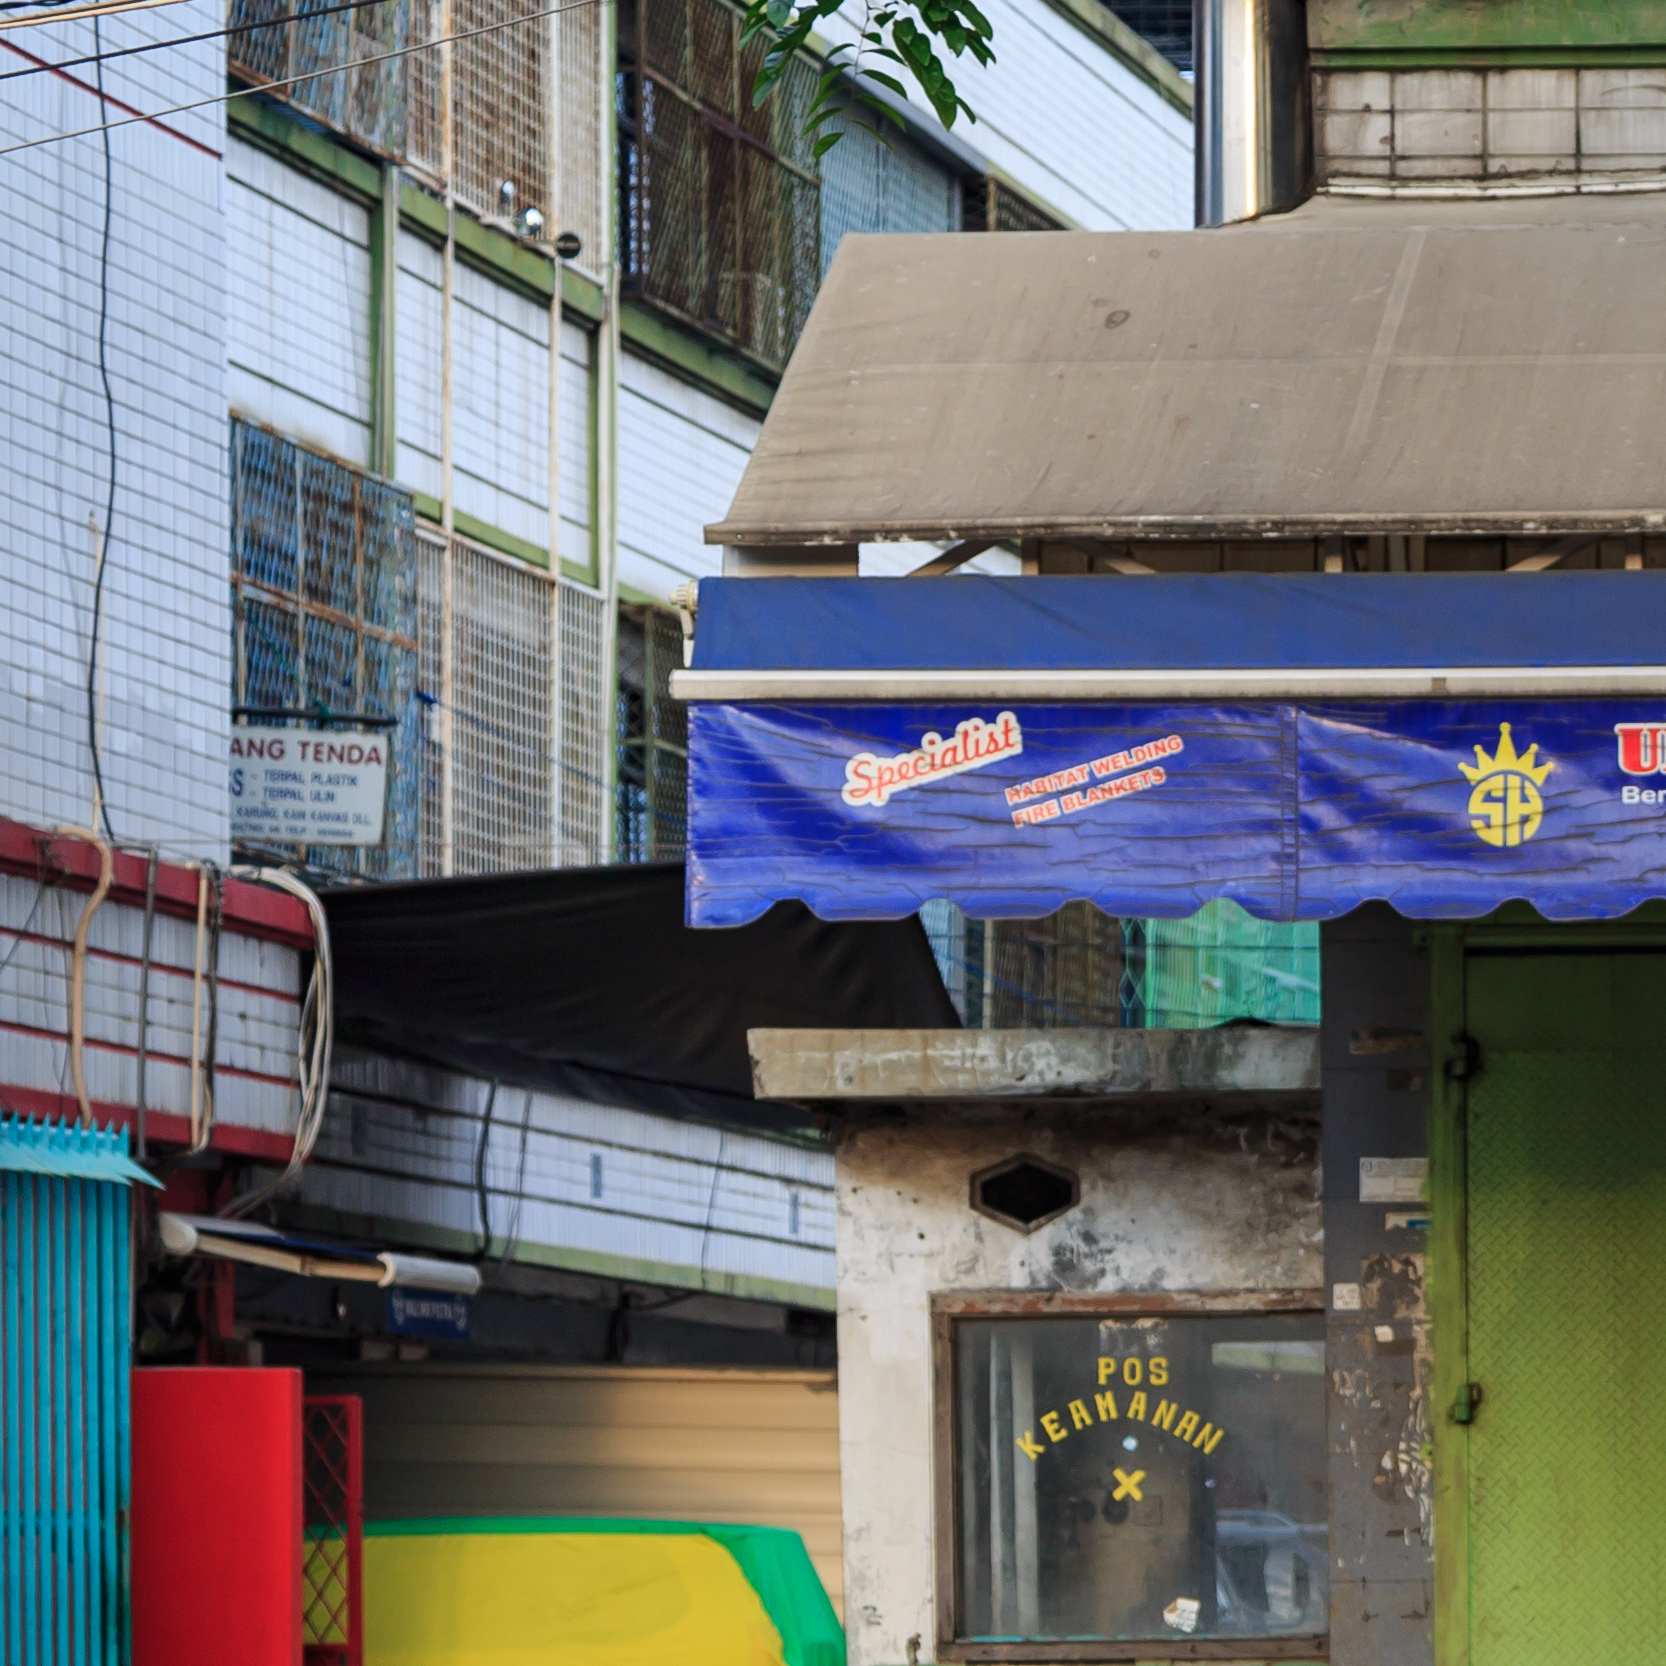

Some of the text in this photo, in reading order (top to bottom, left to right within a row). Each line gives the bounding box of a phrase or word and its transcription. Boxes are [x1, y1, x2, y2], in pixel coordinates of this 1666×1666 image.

[297, 740, 382, 766] TENDA
[846, 717, 1018, 800] Specialist
[1004, 735, 1184, 806] HABITAT WELDING
[263, 786, 305, 801] TERPAL
[264, 769, 359, 786] TERPAL PLASTIK
[1012, 766, 1167, 828] FIRE BLANKETS
[1097, 1356, 1169, 1387] POS
[1015, 1390, 1225, 1461] KEAMANAN
